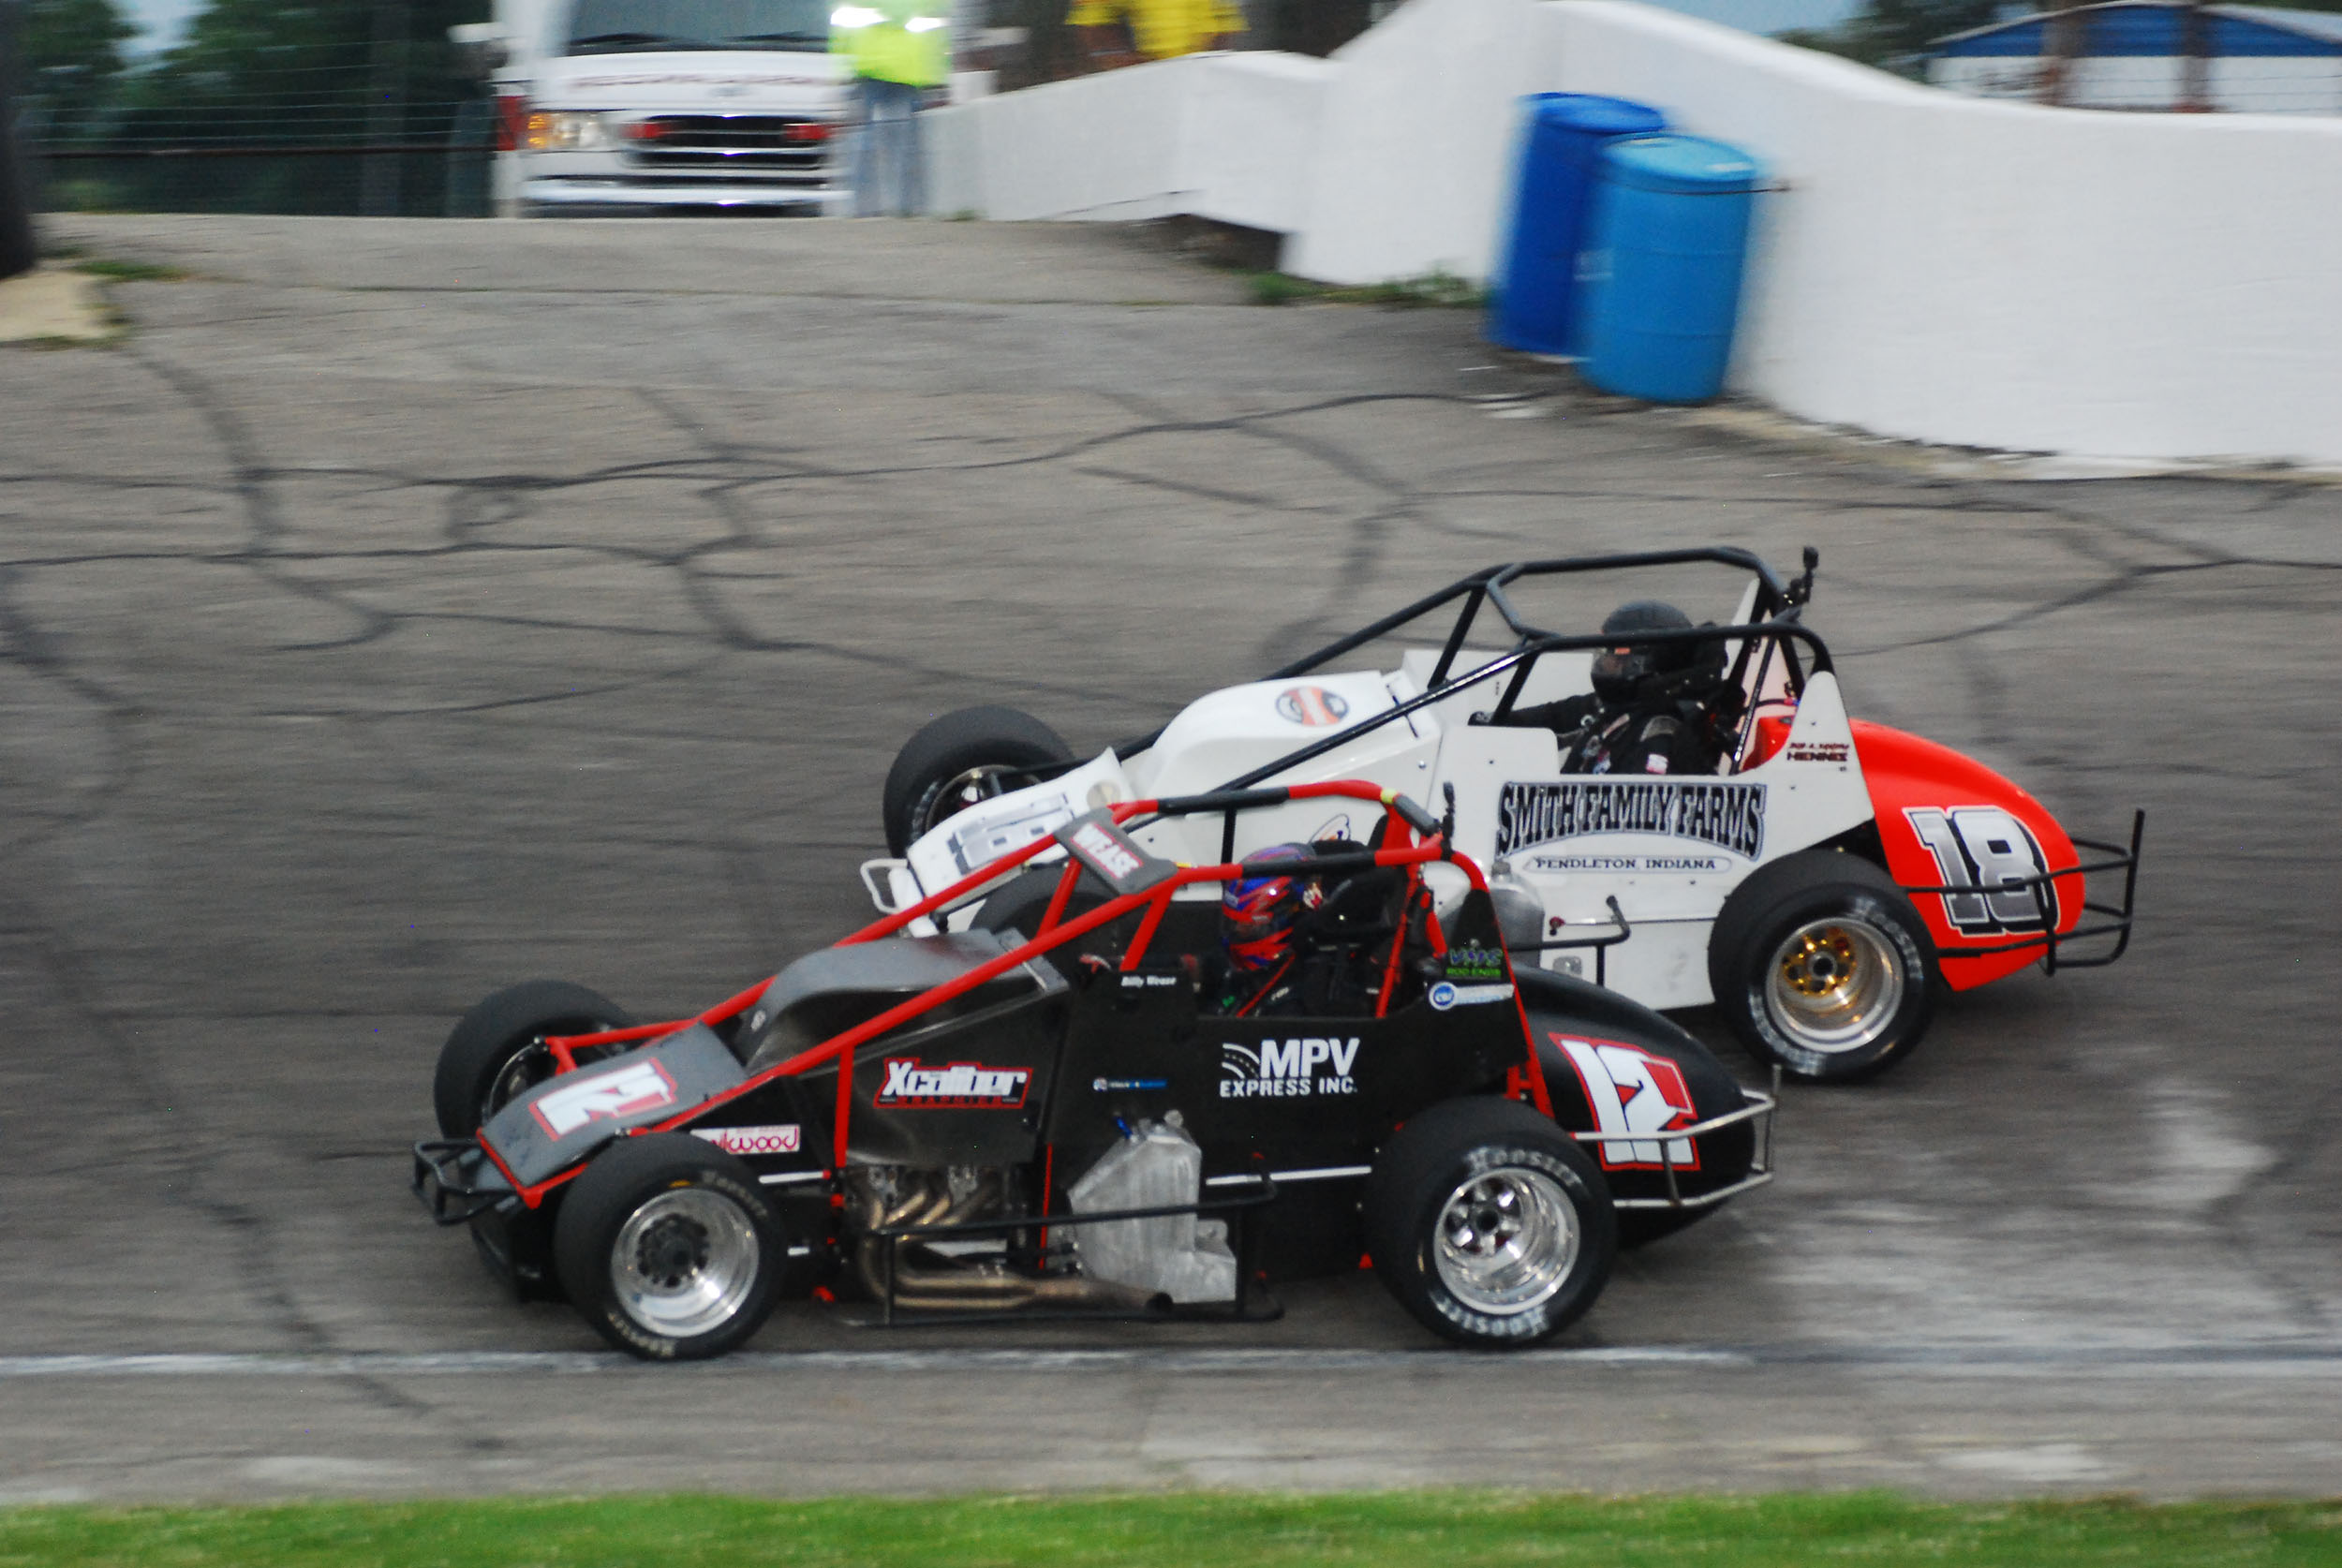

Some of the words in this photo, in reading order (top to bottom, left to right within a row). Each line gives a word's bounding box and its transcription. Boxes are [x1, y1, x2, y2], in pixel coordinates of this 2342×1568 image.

[1496, 783, 1580, 857] SMITH
[1581, 783, 1676, 834] FAMILY
[1676, 783, 1766, 861] FARMS
[1535, 855, 1637, 870] PENDLETON
[1645, 858, 1717, 870] INDIANA
[1903, 806, 2059, 937] 18
[1220, 1079, 1312, 1097] EXPRESS
[1318, 1076, 1358, 1094] INC.
[1260, 1037, 1360, 1078] MPV
[1550, 1033, 1700, 1170] 12
